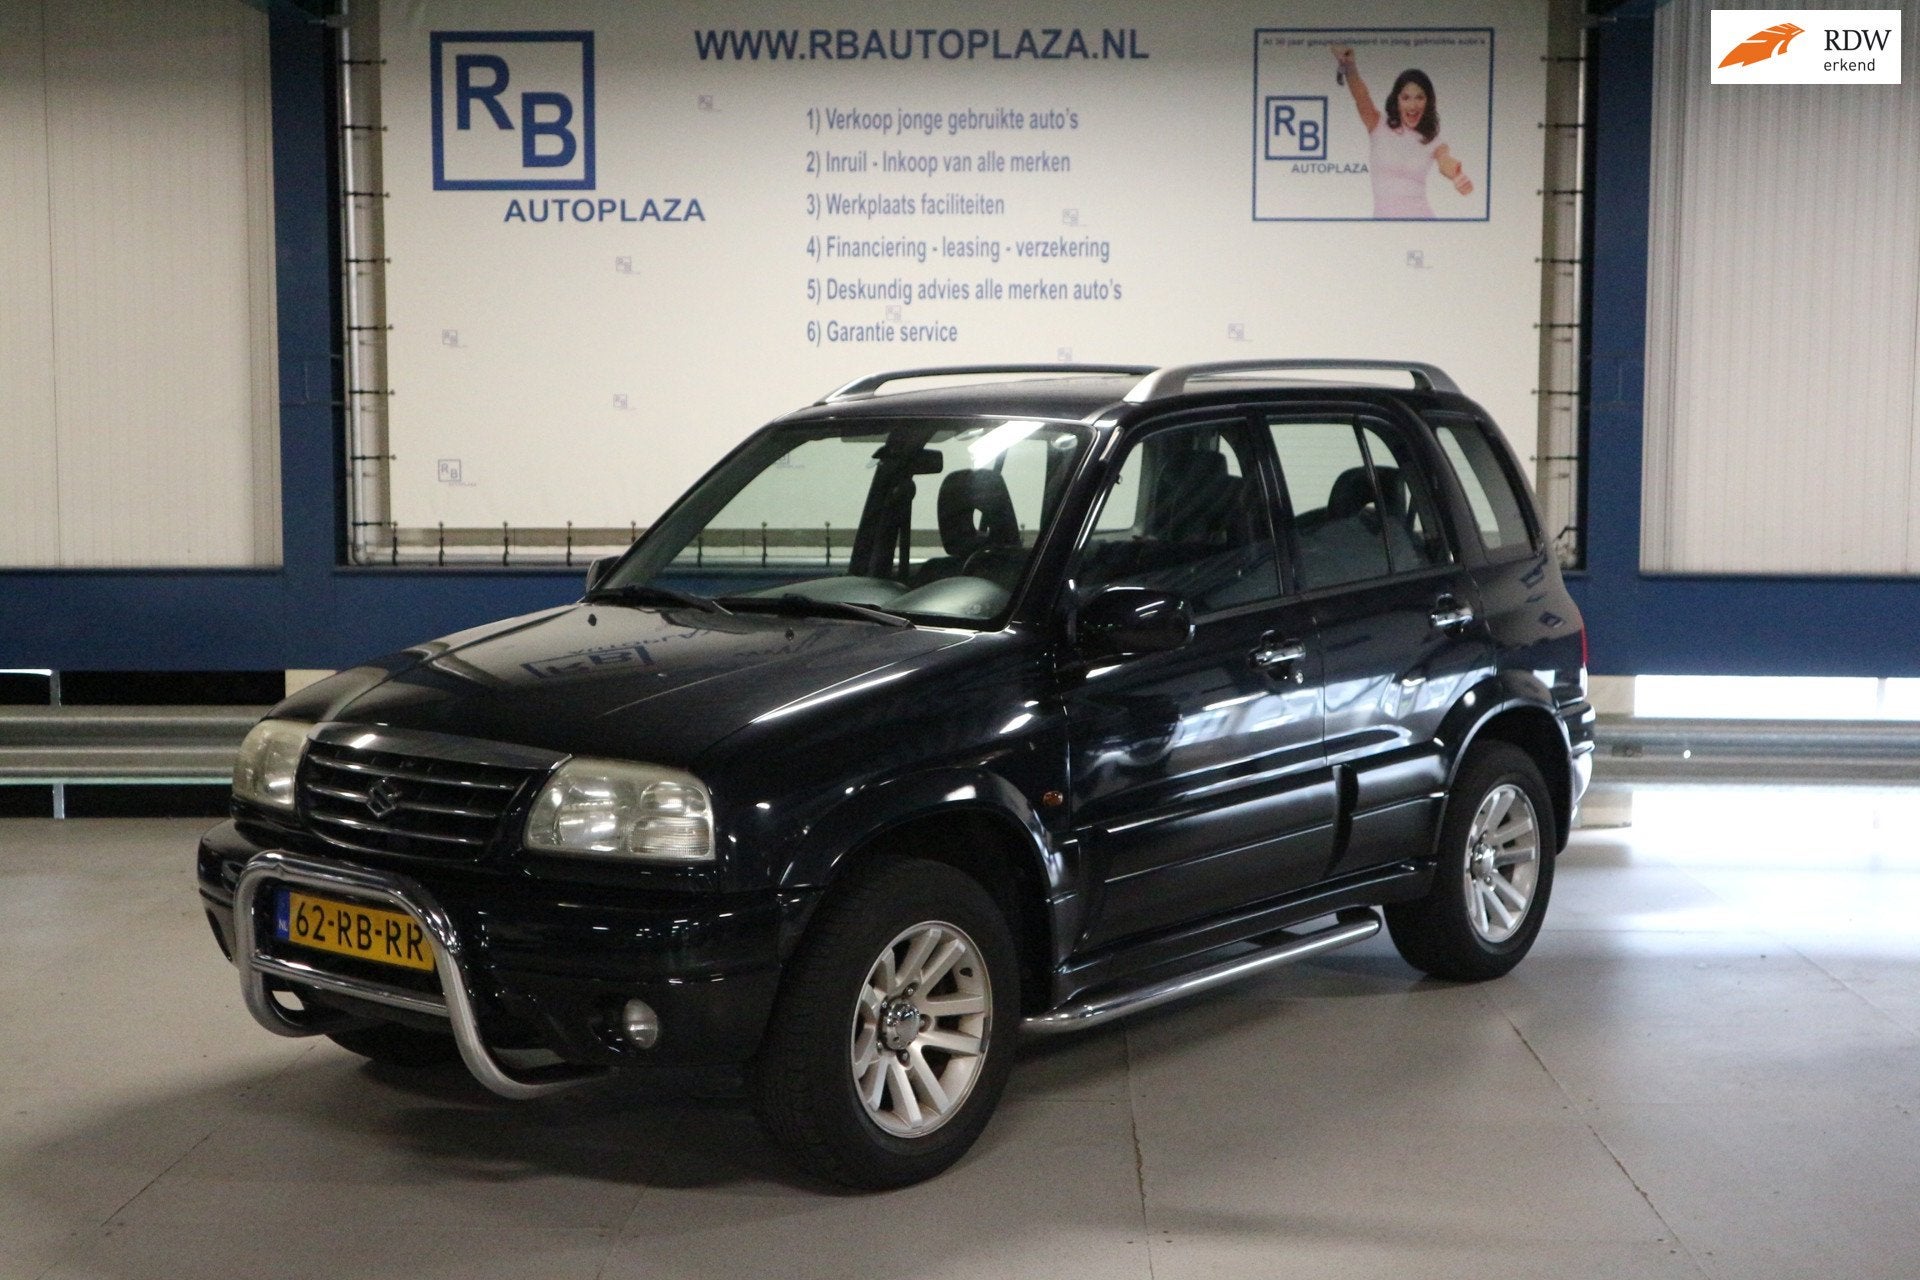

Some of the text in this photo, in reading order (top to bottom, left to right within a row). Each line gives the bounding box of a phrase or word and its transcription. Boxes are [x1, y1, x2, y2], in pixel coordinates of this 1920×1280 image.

[695, 29, 1149, 60] WWW.RBAUTOPLAZA.NL
[806, 108, 1079, 135] 1) Verkoop jonge gebruikte auto's
[806, 150, 821, 177] 2)
[826, 150, 867, 172] Inruil
[883, 151, 938, 177] Inkoop
[944, 156, 972, 172] van
[977, 151, 1005, 172] alle
[1010, 151, 1071, 173] merken
[1291, 162, 1369, 174] AUTOPLAZA
[504, 198, 706, 223] AUTOPLAZA
[806, 193, 1005, 220] 3) Werkplaats faciliteiten
[806, 236, 822, 263] 4)
[826, 236, 927, 264] Financiering
[942, 236, 1000, 264] leasing
[1016, 237, 1110, 264] verzekering
[806, 278, 1123, 306] 5) Deskundig advies alle merken auto's
[806, 320, 958, 347] 6) Garantie service
[296, 902, 424, 961] 62-RB-RR
